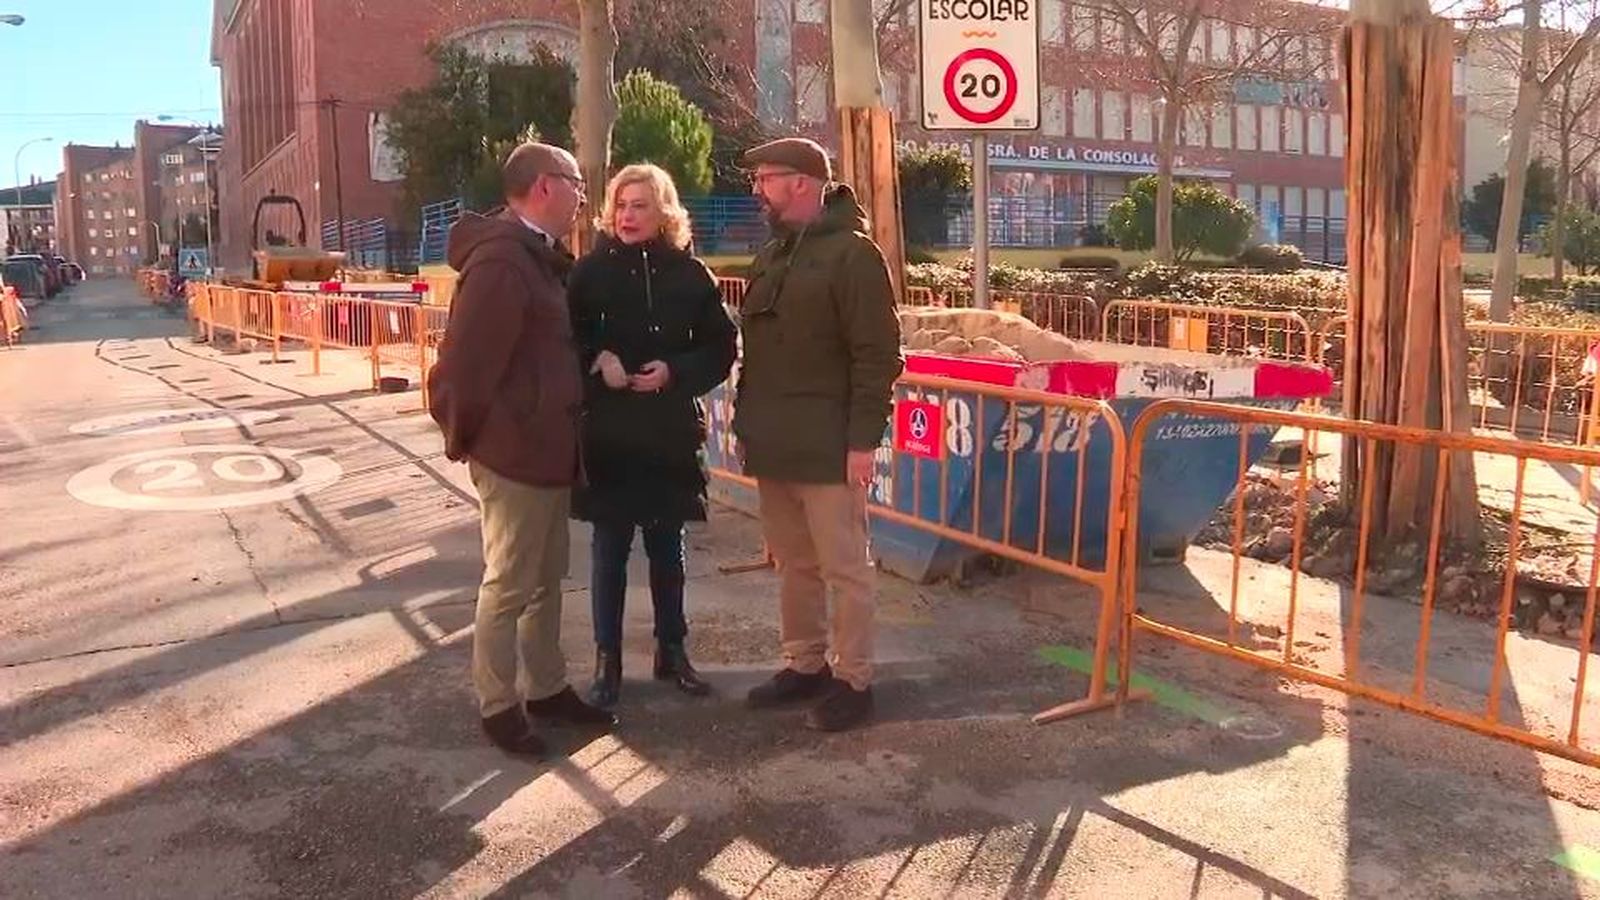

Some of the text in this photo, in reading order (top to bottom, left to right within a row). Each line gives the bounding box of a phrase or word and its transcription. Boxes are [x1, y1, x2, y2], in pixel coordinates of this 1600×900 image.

[928, 0, 1029, 21] ESCOLAR
[960, 73, 1001, 98] 20
[1029, 145, 1049, 160] DE
[1057, 148, 1076, 161] LA
[134, 455, 286, 491] 20
